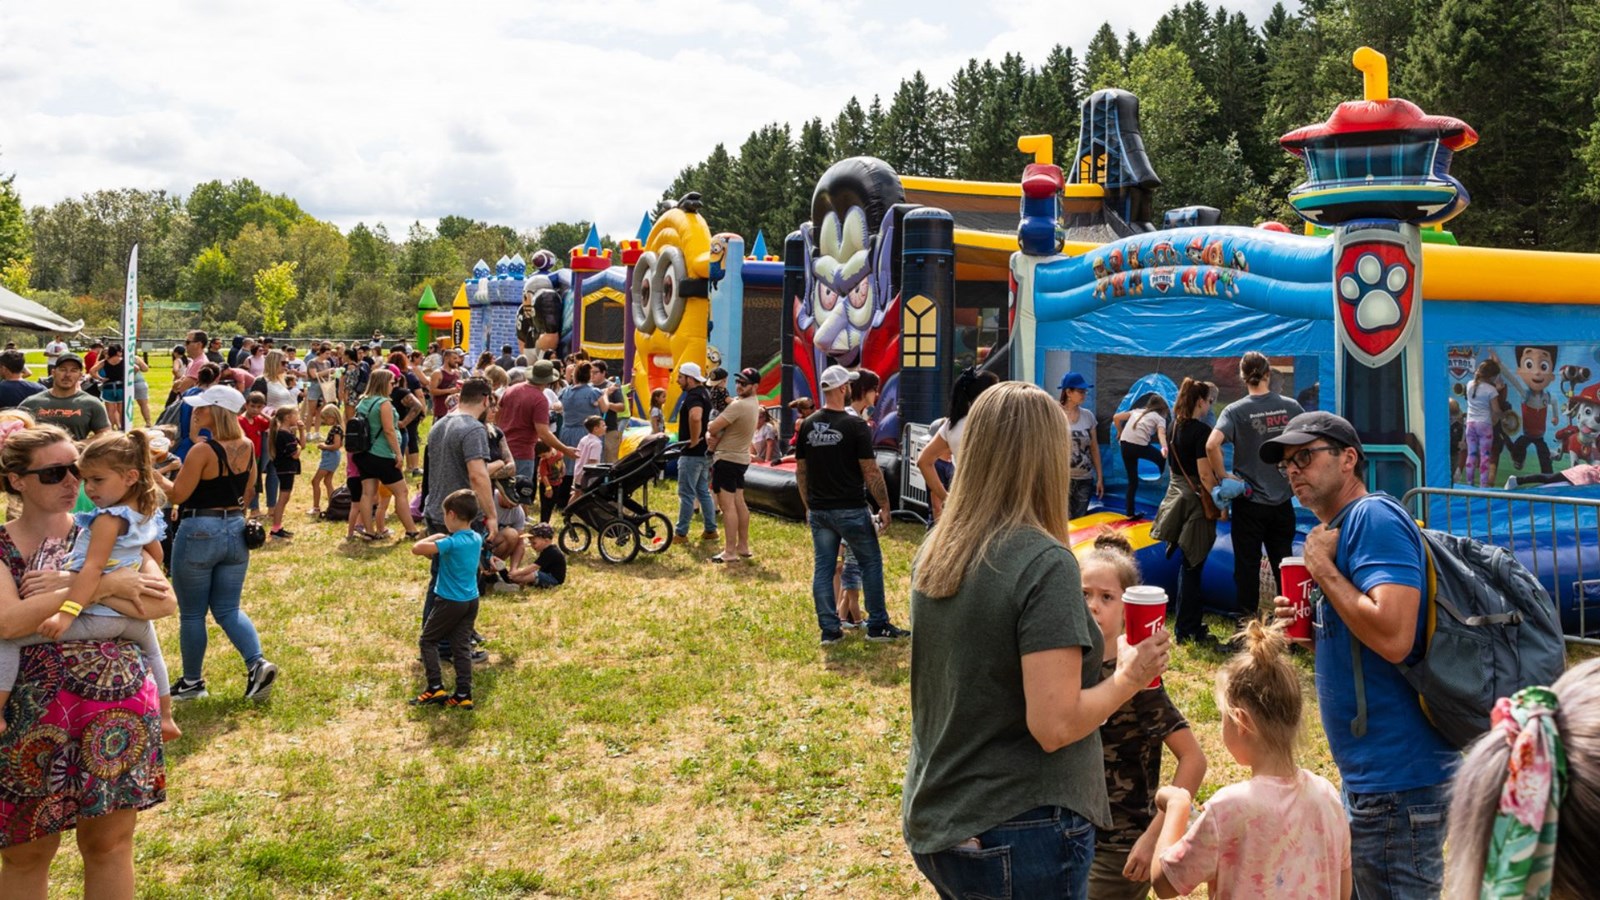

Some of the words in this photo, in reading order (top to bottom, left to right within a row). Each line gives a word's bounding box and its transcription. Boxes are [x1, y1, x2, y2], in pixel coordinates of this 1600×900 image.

[1266, 415, 1289, 427] RVC
[1297, 579, 1312, 599] Ti
[1144, 615, 1164, 635] Ti
